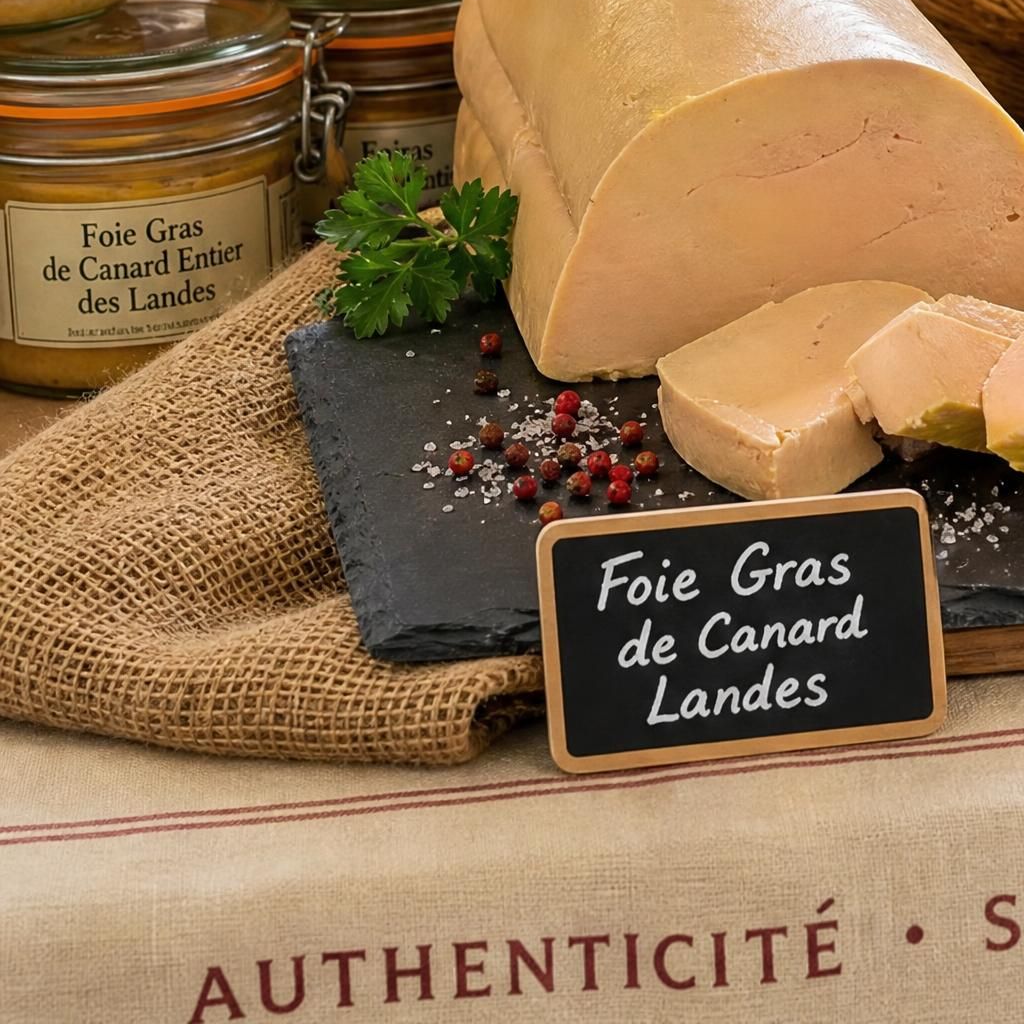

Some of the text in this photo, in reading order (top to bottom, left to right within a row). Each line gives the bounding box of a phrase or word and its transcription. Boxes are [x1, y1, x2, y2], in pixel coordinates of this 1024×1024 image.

[43, 242, 243, 281] de Canard Entier
[81, 218, 203, 247] Foie Gras
[79, 279, 215, 314] des Landes
[597, 542, 850, 611] Foie Gras
[618, 594, 868, 668] de Canard
[647, 663, 828, 725] Landes
[188, 898, 842, 1024] AUTHENTICITÉ
